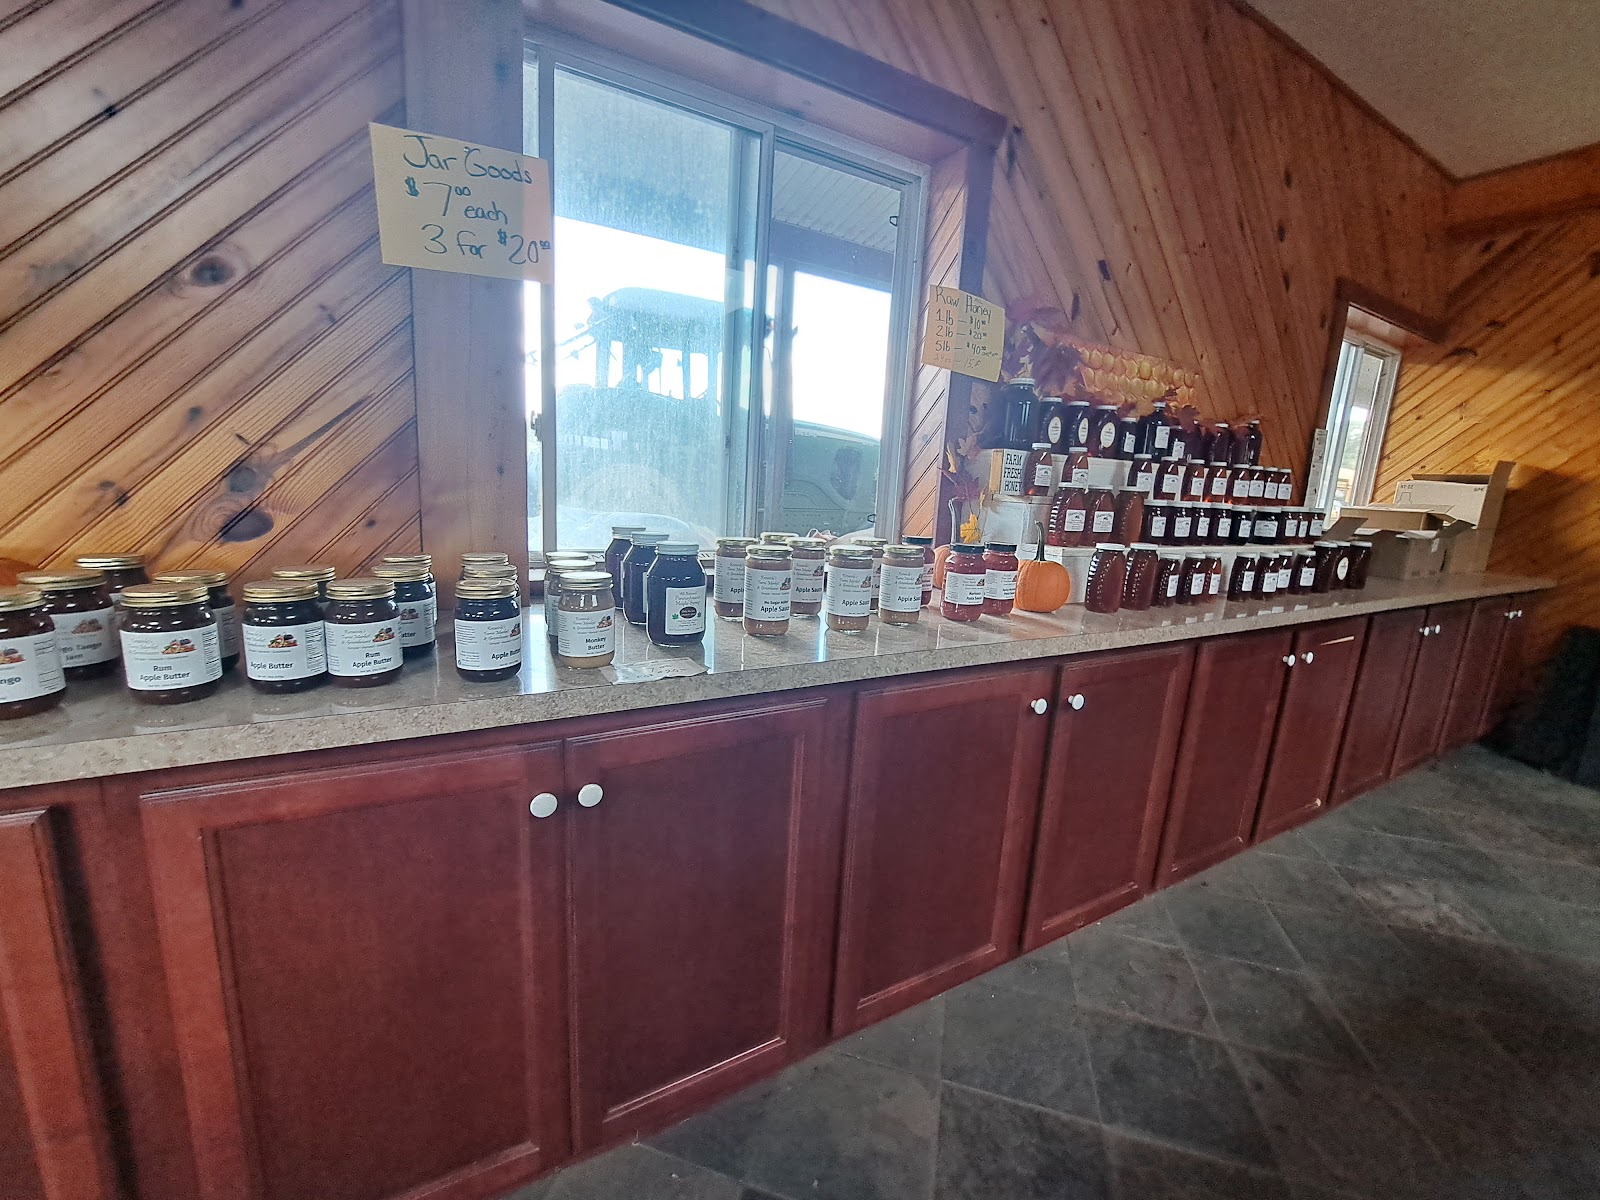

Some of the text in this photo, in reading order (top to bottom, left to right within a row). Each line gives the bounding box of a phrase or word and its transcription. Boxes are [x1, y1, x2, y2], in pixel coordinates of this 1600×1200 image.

[403, 135, 533, 184] Jar Goods
[463, 200, 509, 225] each
[421, 223, 448, 254] 3
[935, 285, 991, 324] Raw Honey
[1005, 453, 1023, 466] FARM
[1003, 467, 1022, 480] FRESH
[1004, 480, 1022, 492] HONEY
[796, 586, 811, 594] Apple
[585, 636, 607, 644] Monkey
[365, 651, 381, 659] Rum
[491, 651, 510, 660] Apple
[268, 662, 294, 670] Butter
[352, 656, 393, 669] Apple Butter
[163, 671, 191, 681] Butter
